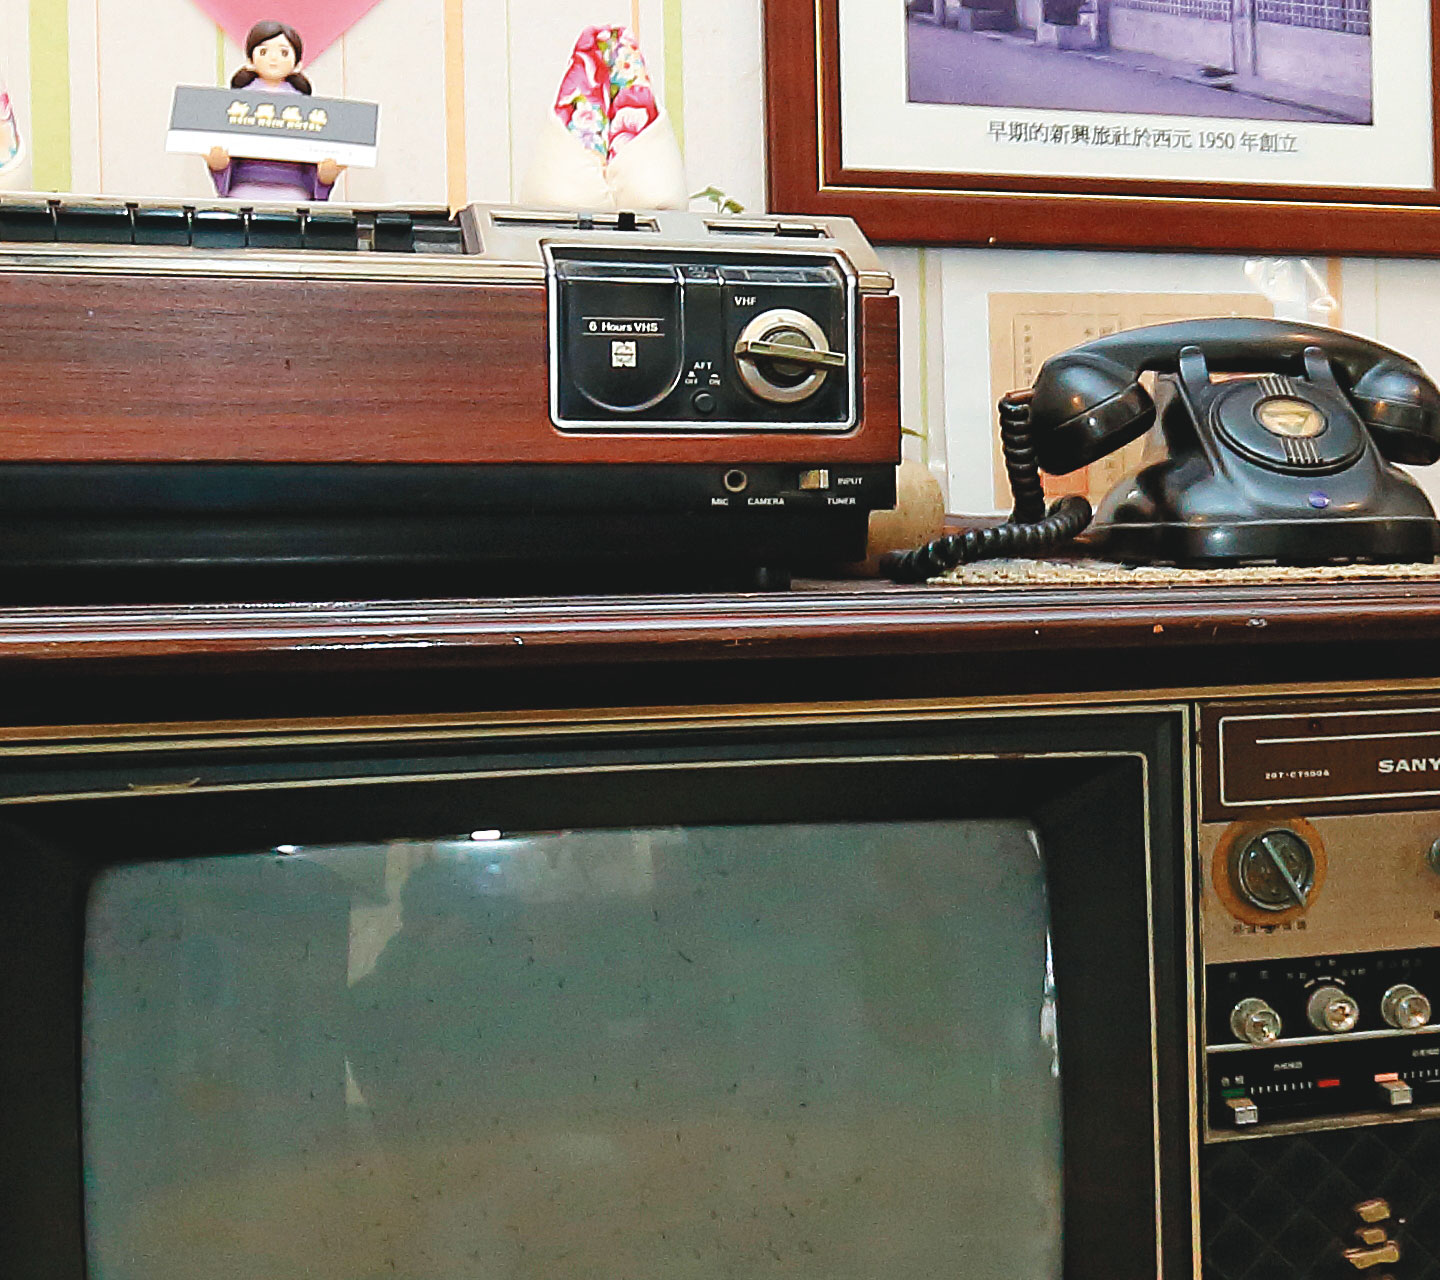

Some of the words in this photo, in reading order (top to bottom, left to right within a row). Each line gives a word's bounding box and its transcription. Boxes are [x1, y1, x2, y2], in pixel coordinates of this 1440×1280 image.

[1198, 131, 1234, 150] 1950
[734, 296, 757, 306] VHF
[589, 321, 598, 331] 6
[601, 321, 632, 332] Hours
[633, 322, 659, 333] VHS
[711, 497, 729, 506] MIC
[747, 497, 785, 506] CAMERA
[827, 497, 857, 506] TUNER
